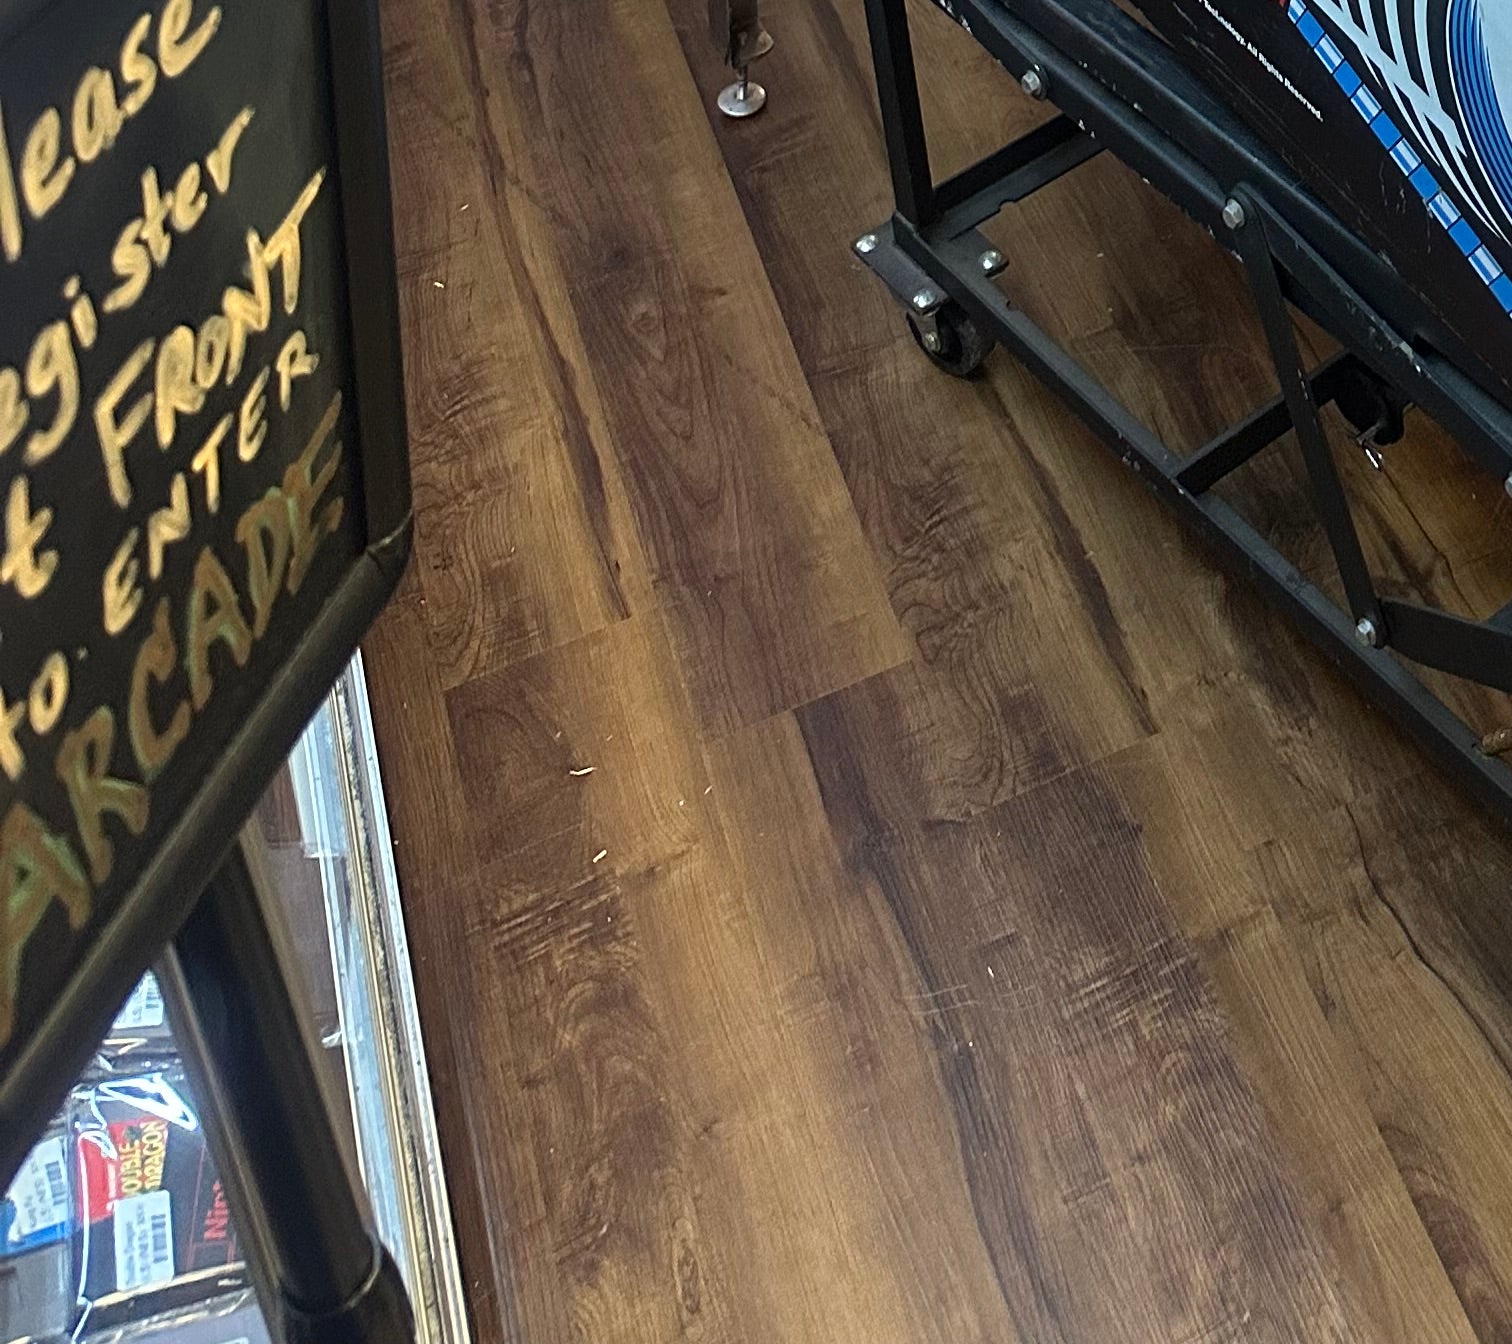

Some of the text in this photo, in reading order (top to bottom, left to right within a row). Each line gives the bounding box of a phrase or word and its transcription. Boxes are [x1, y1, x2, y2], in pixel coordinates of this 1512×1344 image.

[1245, 40, 1259, 61] All
[1258, 53, 1285, 84] Rights
[1283, 76, 1324, 123] Reserved.
[0, 105, 255, 466] egister
[94, 166, 327, 510] FRONT
[102, 328, 320, 636] ENTER
[0, 390, 344, 1044] ARCADE
[119, 1137, 142, 1195] OUBLE
